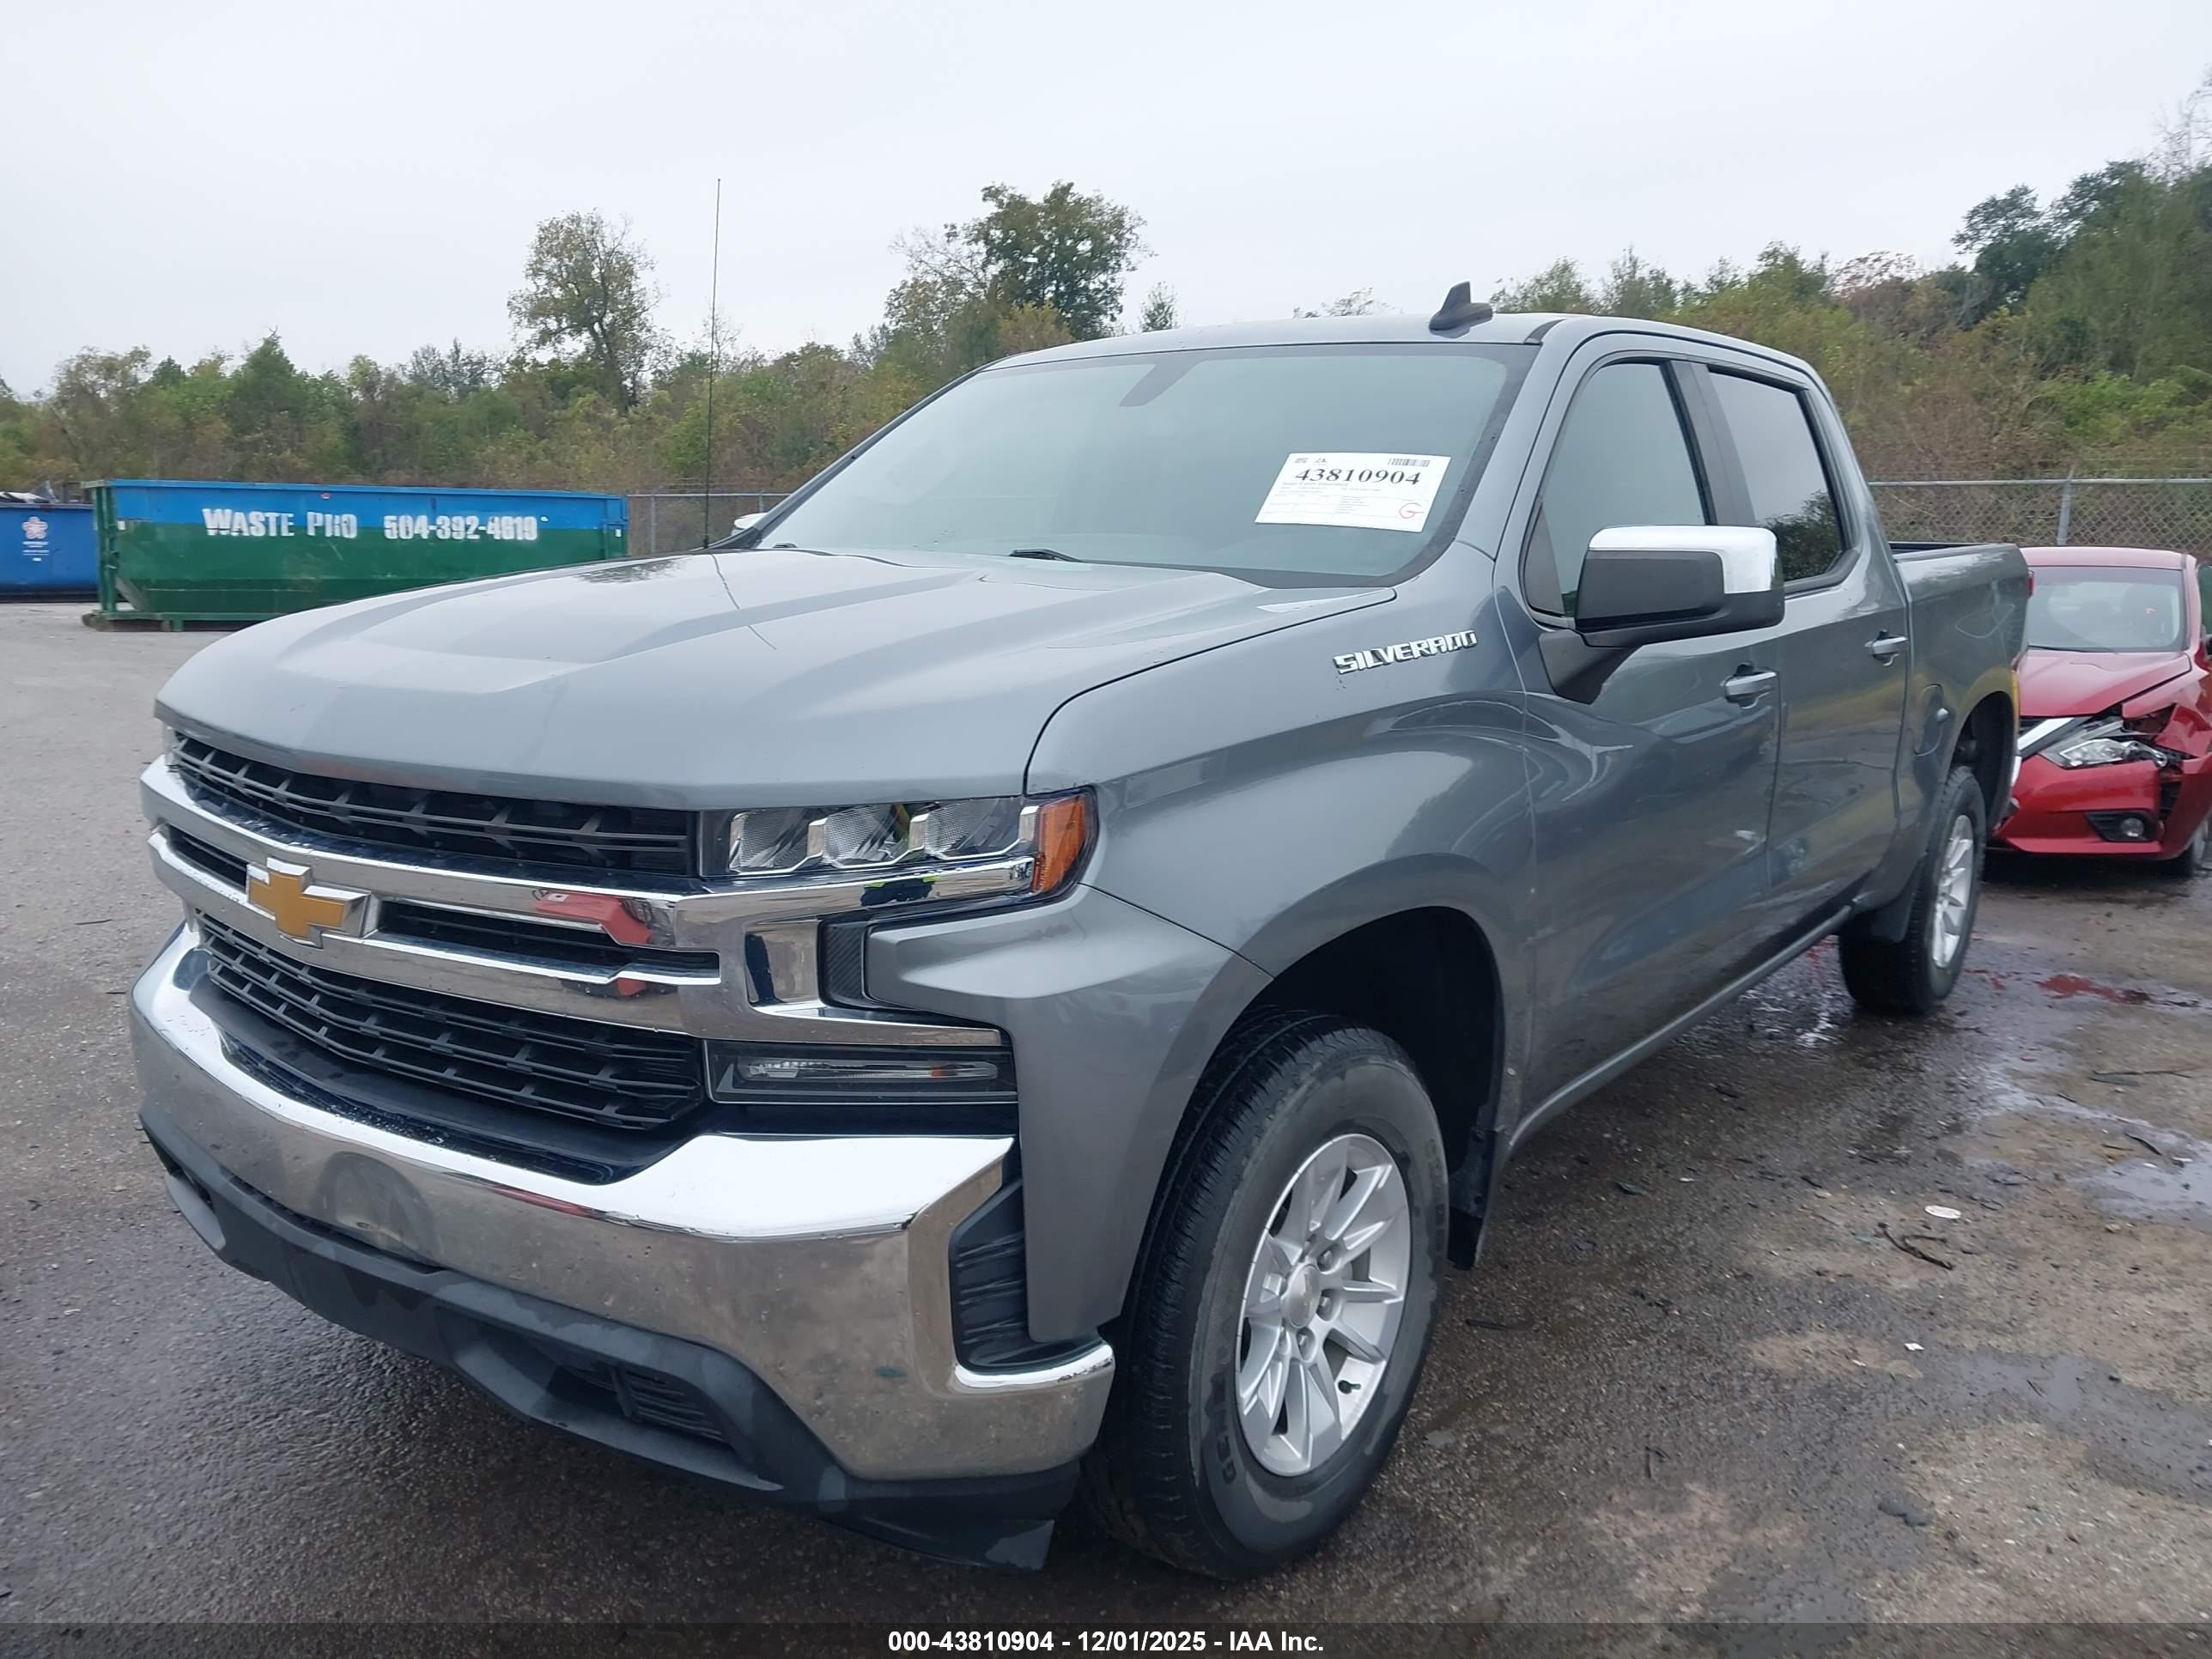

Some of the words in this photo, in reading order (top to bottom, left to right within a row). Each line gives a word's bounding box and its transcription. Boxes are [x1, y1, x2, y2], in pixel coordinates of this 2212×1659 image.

[1295, 468, 1420, 485] 43810904
[202, 508, 295, 537] WASTE
[307, 511, 358, 539] PRO
[1333, 629, 1478, 675] SILVERADO
